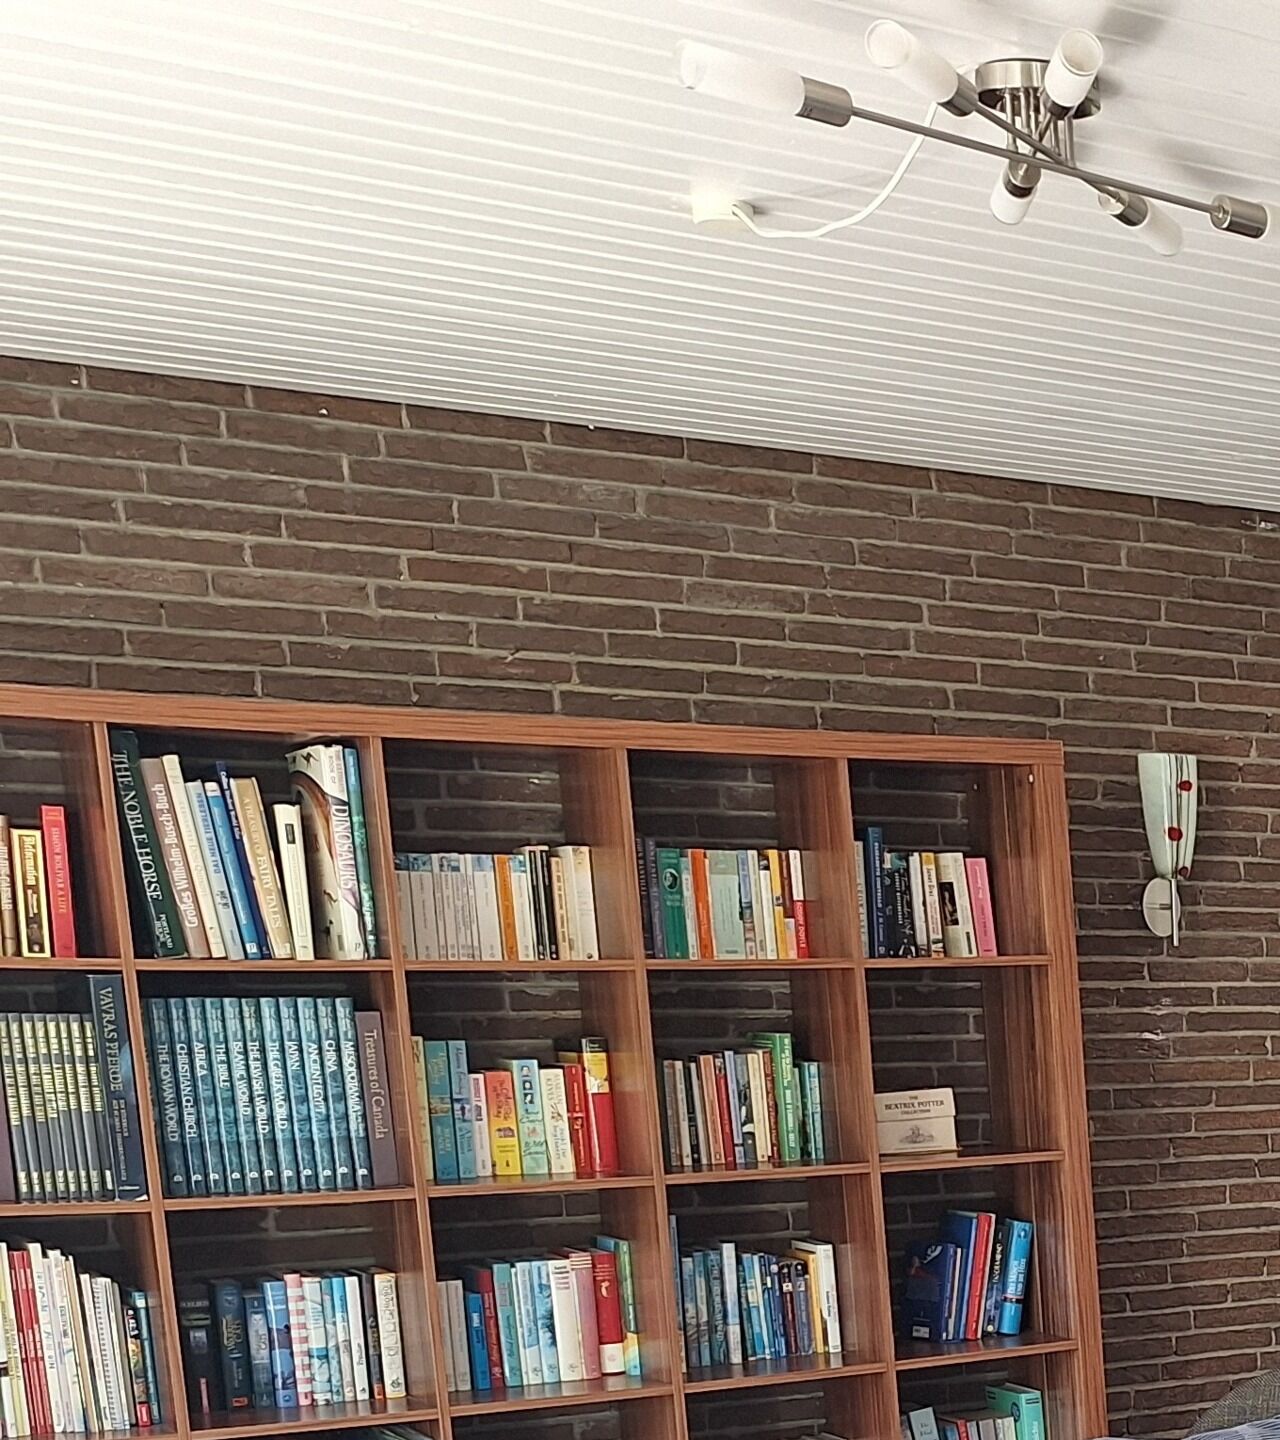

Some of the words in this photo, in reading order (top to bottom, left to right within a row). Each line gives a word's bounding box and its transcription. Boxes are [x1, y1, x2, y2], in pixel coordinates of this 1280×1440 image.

[112, 750, 134, 787] THE
[121, 789, 149, 845] NOBLE
[332, 804, 358, 892] DINOSAURS
[135, 847, 163, 902] HORSE
[256, 855, 271, 889] FAIRY
[265, 894, 282, 929] TALES
[98, 986, 118, 1039] VAVRAS
[105, 1040, 124, 1092] PFERDE
[175, 1042, 193, 1095] CHRISTIAN
[214, 1043, 227, 1062] THE
[232, 1041, 247, 1079] ISLAMIC
[286, 1041, 300, 1071] JAPAN
[307, 1041, 324, 1085] ANCIENT
[324, 1039, 339, 1073] CHINA
[364, 1028, 379, 1079] Treasures
[217, 1063, 231, 1089] BIBLE
[343, 1041, 361, 1115] MESOPOTAMIA
[182, 1096, 198, 1138] CHURCH
[237, 1080, 250, 1116] WORLD
[255, 1097, 269, 1134] WORLD
[274, 1092, 289, 1130] WORLD
[371, 1095, 390, 1140] Canada
[884, 1102, 916, 1111] BEATRIX
[917, 1100, 945, 1109] POTTER
[164, 1103, 179, 1142] WORLD
